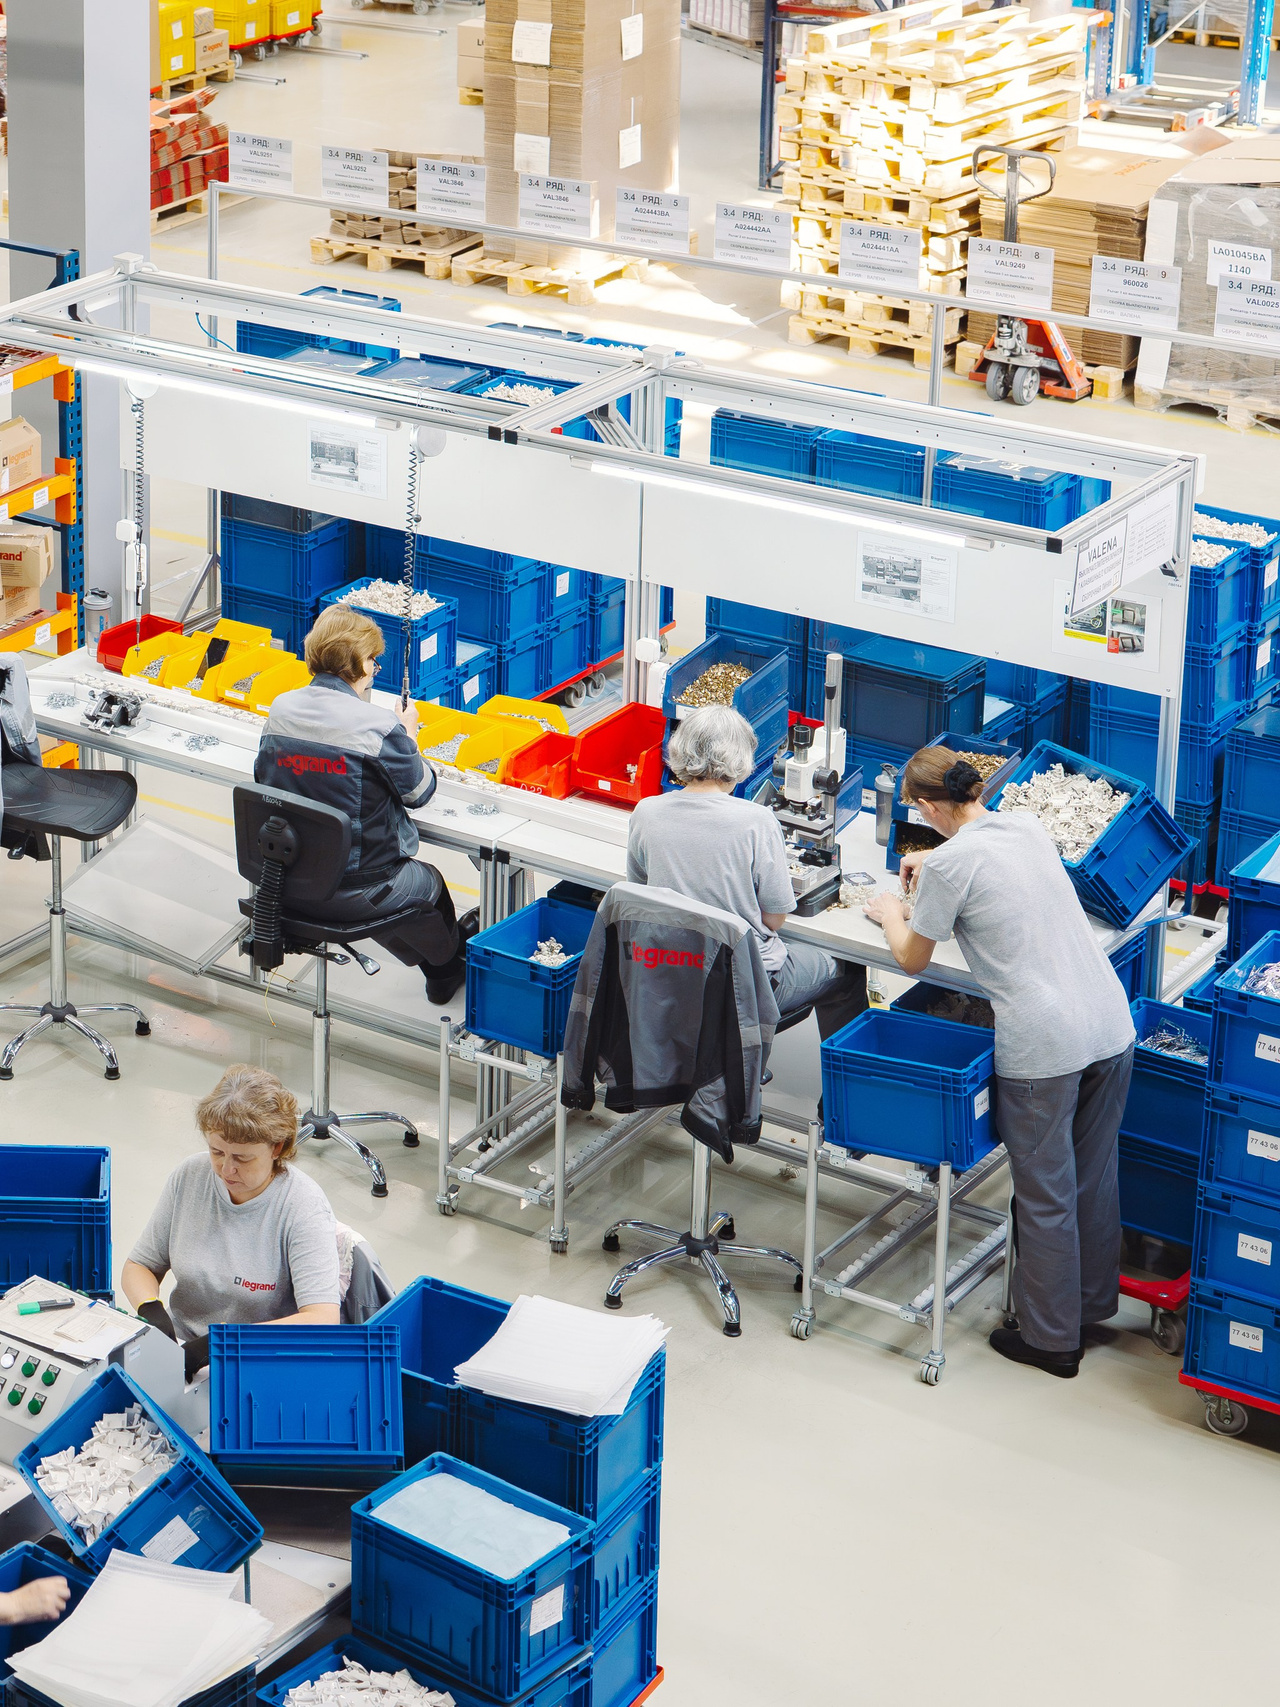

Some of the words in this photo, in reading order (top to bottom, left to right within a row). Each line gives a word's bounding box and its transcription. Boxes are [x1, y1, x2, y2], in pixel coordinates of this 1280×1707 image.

[235, 135, 245, 143] 3.4
[252, 138, 269, 148] РЯД:
[328, 149, 338, 157] 3.4
[345, 152, 363, 161] РЯД:
[424, 163, 435, 171] 3.4
[441, 165, 460, 176] РЯД:
[528, 178, 539, 186] 3.4
[546, 181, 565, 192] РЯД:
[623, 192, 635, 201] 3.4
[642, 195, 662, 206] РЯД:
[723, 208, 735, 216] 3.4
[742, 210, 763, 222] РЯД:
[774, 215, 779, 223] 6
[849, 227, 861, 235] 3.4
[869, 230, 891, 241] РЯД:
[904, 235, 909, 243] 7
[977, 243, 991, 252] 3.4
[999, 246, 1022, 258] РЯД:
[1034, 251, 1039, 259] 8
[1213, 247, 1266, 262] LA01045BA
[994, 259, 1025, 269] VAL9249
[1101, 261, 1116, 271] 3.4
[1124, 265, 1148, 277] РЯД:
[1160, 270, 1166, 279] 9
[1228, 264, 1251, 275] 1140
[1122, 278, 1148, 288] 960026
[1227, 280, 1242, 290] 3.4
[1251, 283, 1276, 296] РЯД:
[1246, 297, 1279, 308] VAL0025
[9, 447, 33, 465] legrand
[0, 551, 23, 561] rand
[1087, 536, 1118, 563] VALENA
[632, 941, 706, 970] legrand
[1258, 1041, 1266, 1050] 77
[1267, 1044, 1276, 1053] 44
[1250, 1137, 1259, 1145] 77
[1260, 1140, 1268, 1148] 43
[1270, 1142, 1279, 1150] 06
[1240, 1241, 1249, 1249] 77
[1250, 1244, 1258, 1252] 43
[1260, 1247, 1268, 1255] 06
[242, 1279, 276, 1292] legrand
[1232, 1328, 1240, 1336] 77
